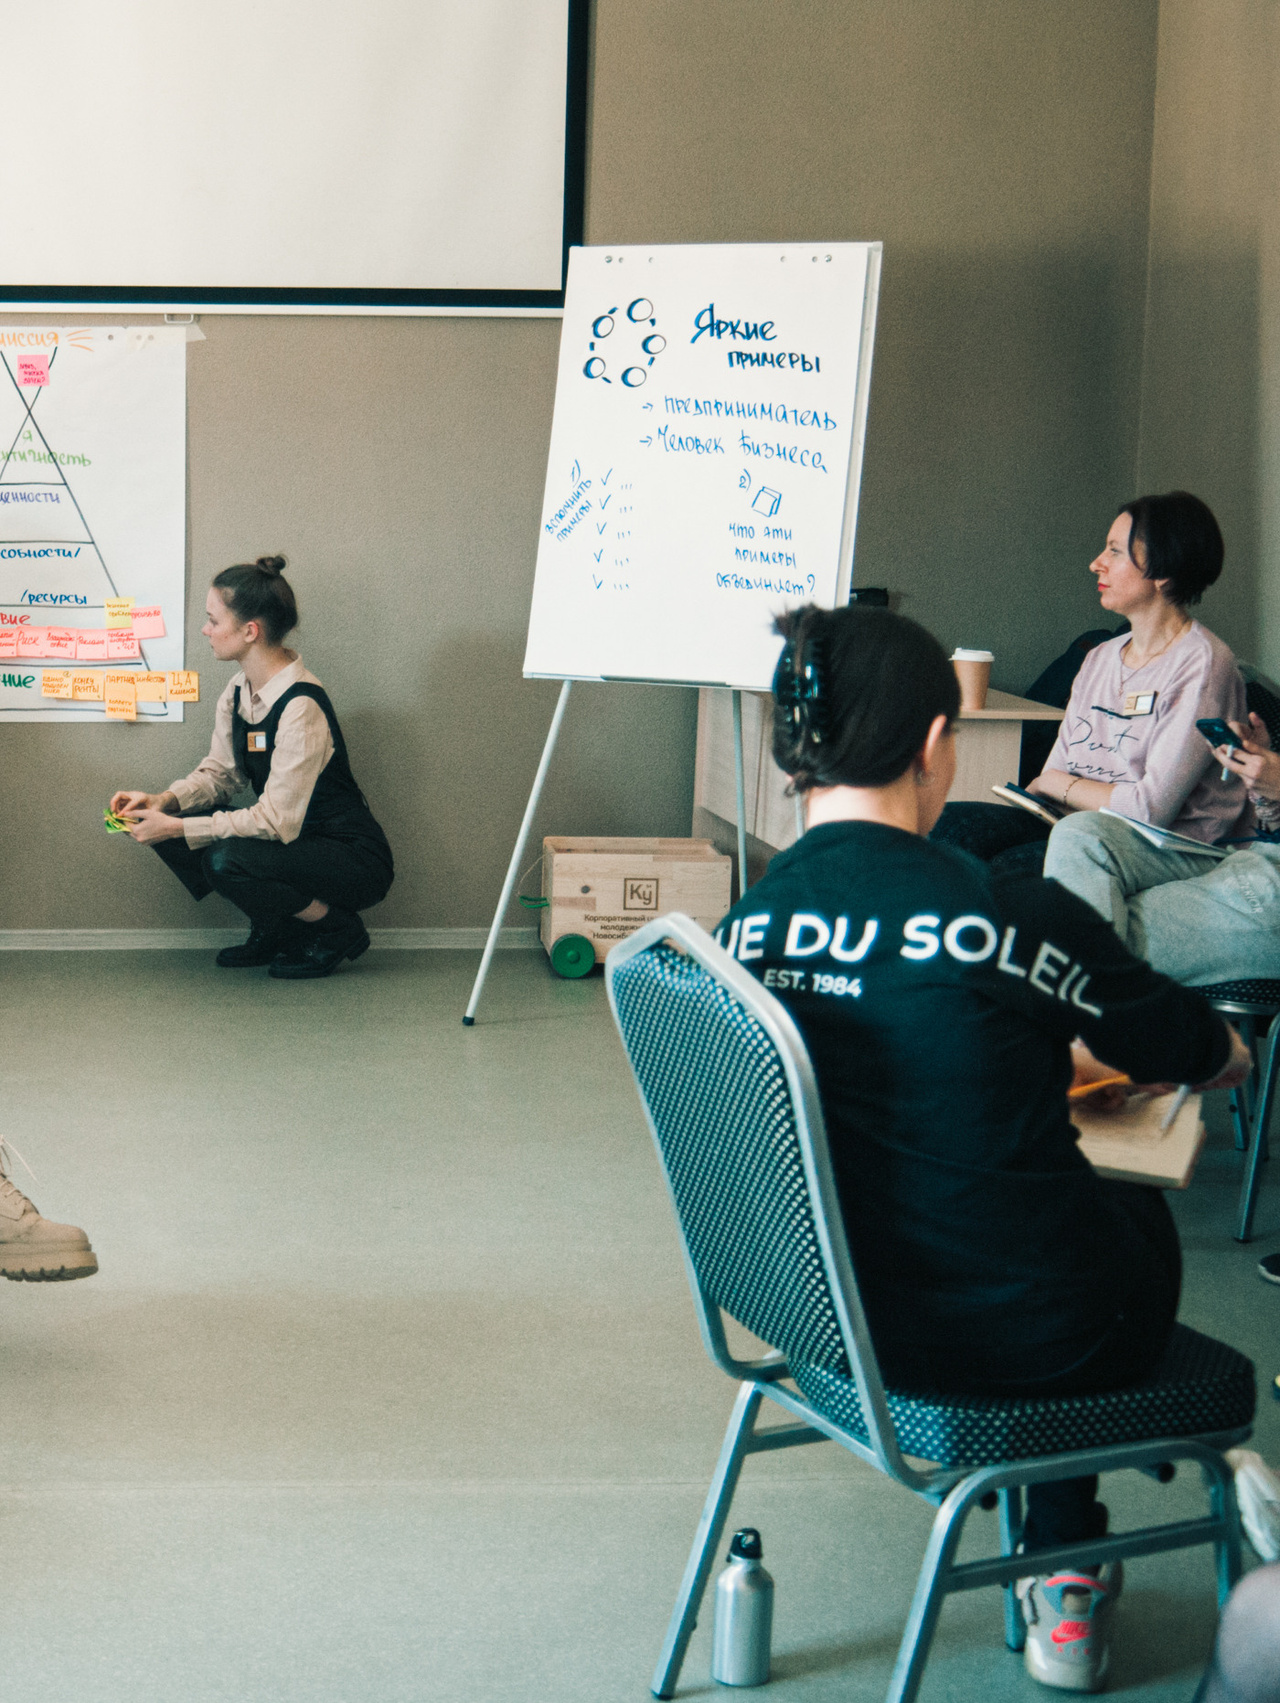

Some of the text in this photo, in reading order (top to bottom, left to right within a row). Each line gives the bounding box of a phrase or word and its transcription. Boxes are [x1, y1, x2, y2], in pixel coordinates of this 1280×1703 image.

[690, 303, 778, 344] Яркие
[584, 913, 646, 922] Корпоративный
[762, 967, 862, 998] EST. 1984
[783, 912, 878, 962] DU
[900, 914, 1103, 1018] SOLEIL
